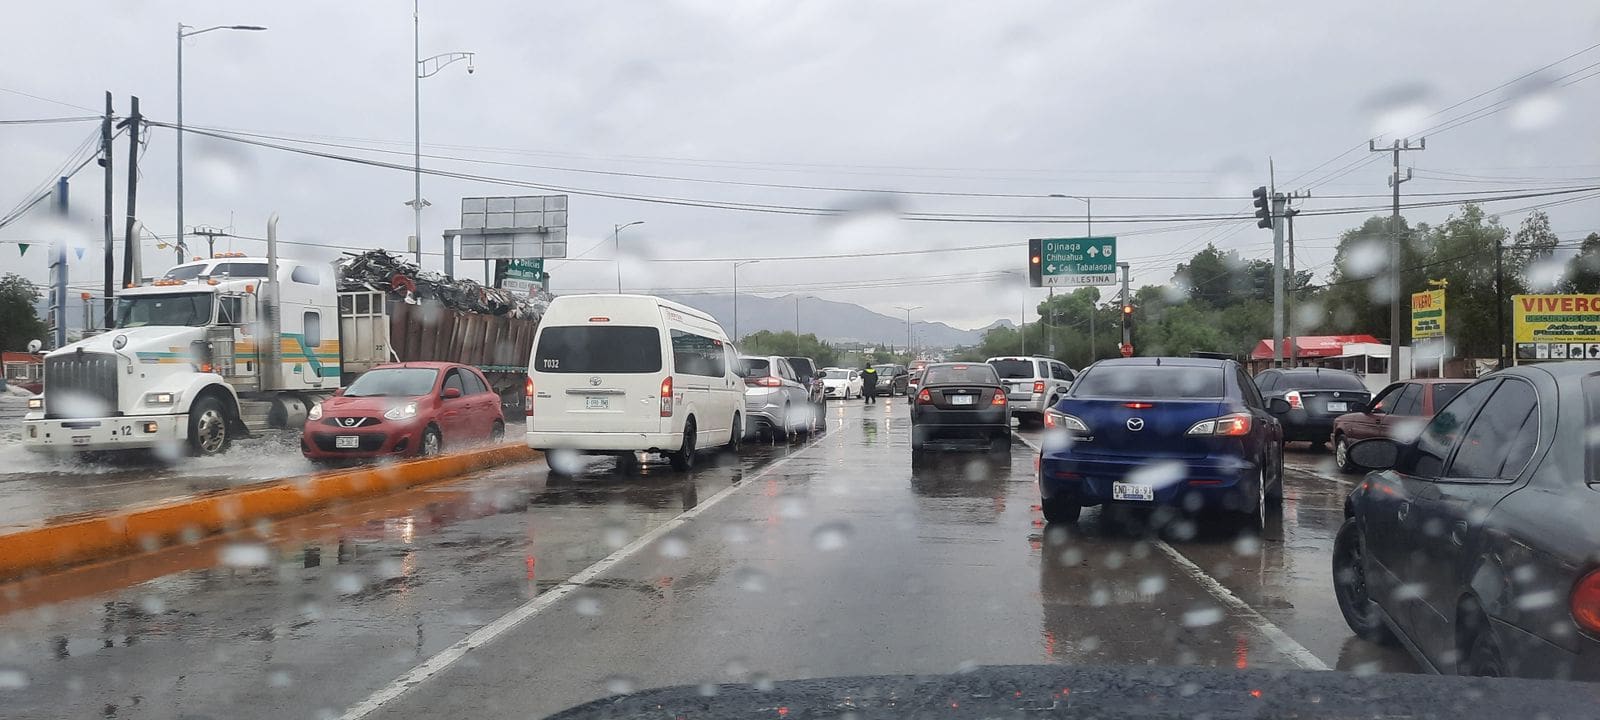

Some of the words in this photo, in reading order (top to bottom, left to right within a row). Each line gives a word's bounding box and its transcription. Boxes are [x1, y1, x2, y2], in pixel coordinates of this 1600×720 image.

[1047, 243, 1081, 253] Ojinaga
[1046, 253, 1084, 262] Chihuahua
[1077, 263, 1112, 272] Tabalaopa
[1412, 294, 1431, 310] VIVERO
[544, 360, 560, 368] T032
[120, 426, 132, 436] 12
